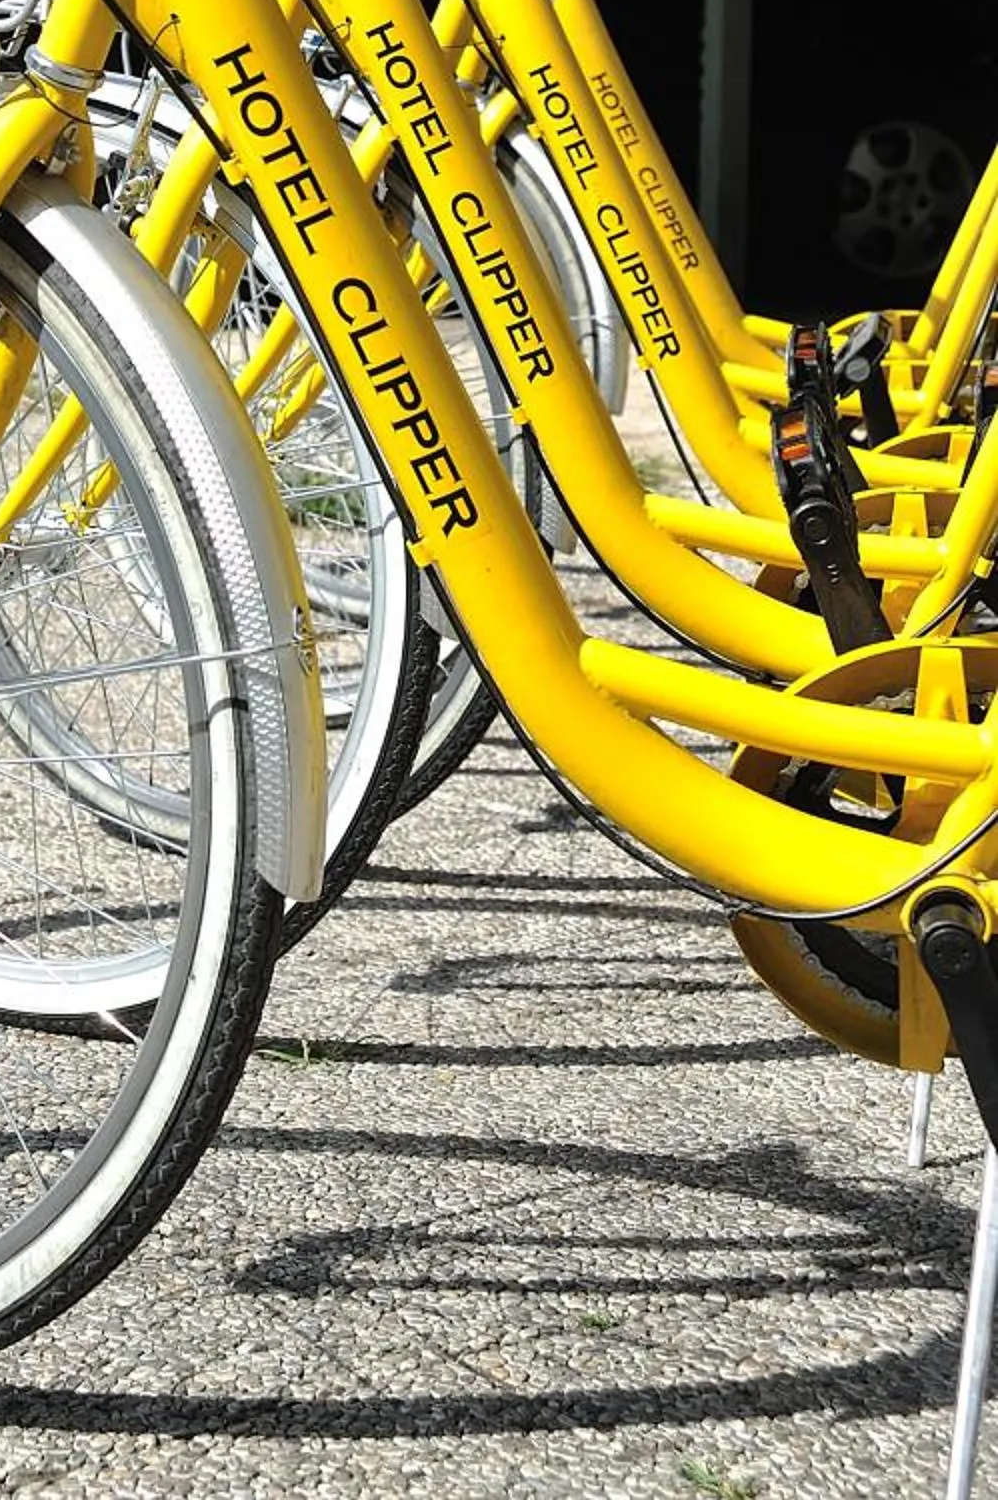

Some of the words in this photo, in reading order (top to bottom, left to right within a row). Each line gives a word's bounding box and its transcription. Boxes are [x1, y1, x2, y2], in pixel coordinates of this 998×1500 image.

[214, 43, 335, 255] HOTEL
[332, 277, 479, 537] CLIPPER
[366, 20, 453, 176] HOTEL
[451, 191, 555, 383] CLIPPER
[529, 63, 599, 190] HOTEL
[597, 203, 681, 360] CLIPPER
[591, 71, 640, 157] HOTEL
[638, 166, 700, 271] CLIPPER
